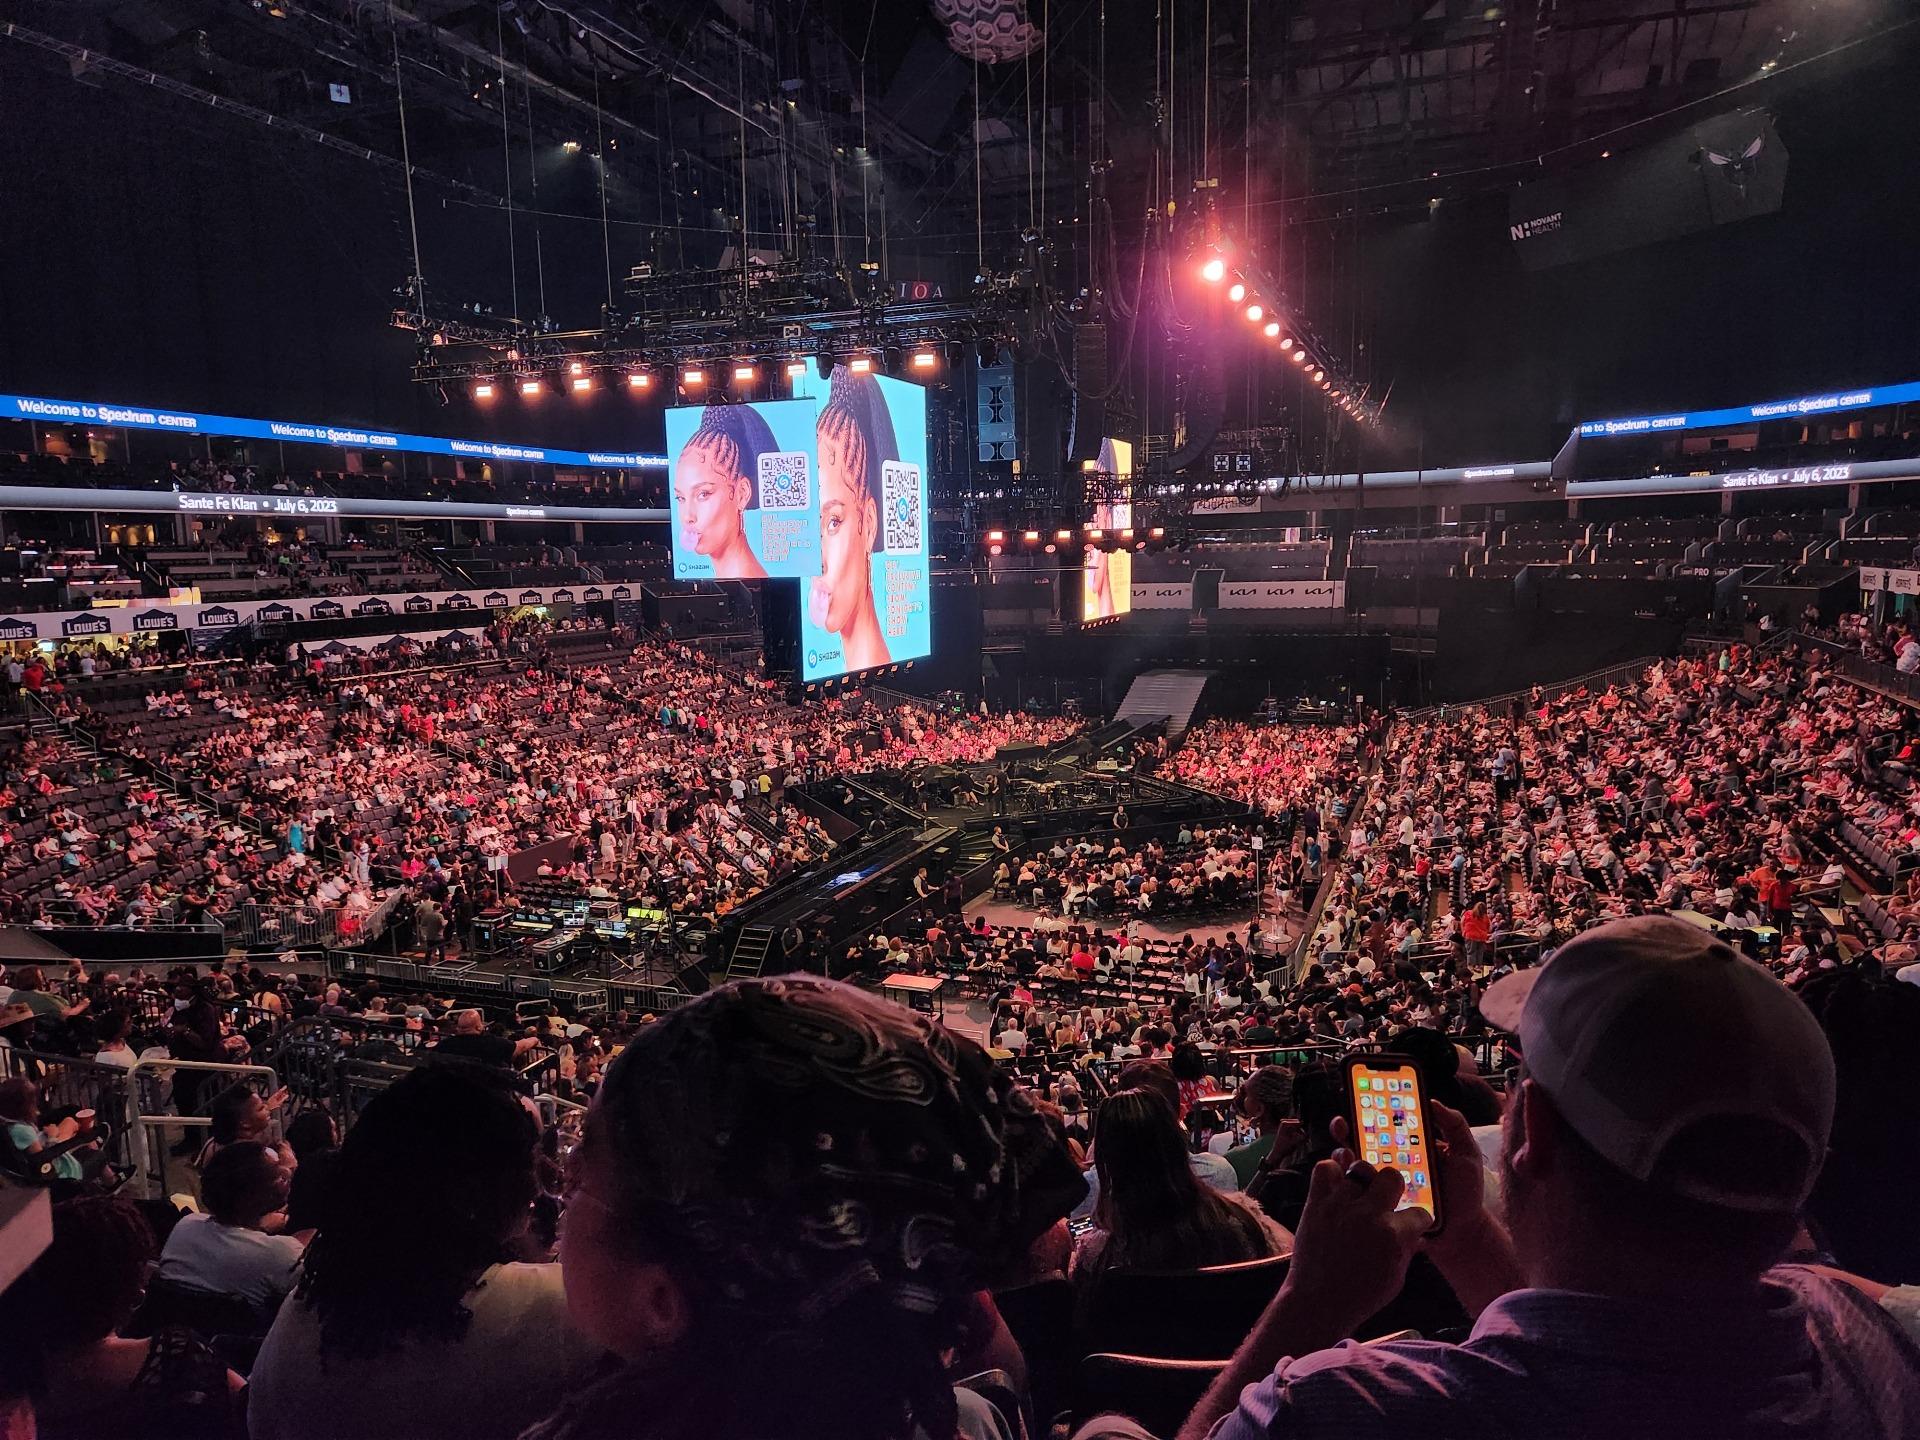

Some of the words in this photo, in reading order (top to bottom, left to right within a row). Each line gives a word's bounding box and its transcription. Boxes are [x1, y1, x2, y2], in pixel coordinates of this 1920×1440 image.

[1530, 212, 1562, 228] NOVANT
[1752, 405, 1787, 416] Welcome
[1788, 402, 1798, 412] to
[1798, 397, 1838, 413] Spectrum
[1840, 394, 1871, 406] CENTER
[17, 399, 80, 417] Welcome
[82, 405, 97, 418] to
[98, 406, 155, 424] Spectrum
[158, 414, 197, 428] CENTER
[1594, 423, 1605, 433] to
[1605, 419, 1650, 434] Spectrum
[1651, 416, 1686, 428] CENTER
[271, 423, 315, 438] Welcome
[315, 428, 327, 439] to
[327, 429, 368, 443] Spectrum
[369, 434, 398, 446] CENTER
[450, 441, 483, 453] Welcome
[483, 444, 492, 454] to
[492, 446, 523, 457] Spectrum
[588, 453, 625, 464] Welcome
[626, 455, 635, 464] to
[1723, 475, 1746, 488] Sante
[1746, 473, 1759, 486] Fe
[1758, 471, 1779, 484] Klan
[1791, 470, 1811, 484] July
[1810, 470, 1822, 482] 6,
[1822, 466, 1850, 480] 2023
[178, 495, 216, 509] Sante
[215, 496, 230, 510] Fe
[231, 497, 258, 511] Klan
[274, 499, 297, 514] July
[297, 500, 309, 514] 6,
[309, 500, 338, 513] 2023
[1694, 567, 1710, 576] PRO
[1156, 589, 1182, 597] KIA
[1229, 588, 1257, 596] KIA
[1304, 587, 1333, 595] KIA
[485, 597, 507, 606] LOWE'S
[521, 595, 541, 604] LOWE'S
[137, 616, 174, 629] LOWE'S
[202, 613, 236, 624] LOWE'S
[66, 620, 107, 634] LOWE'S
